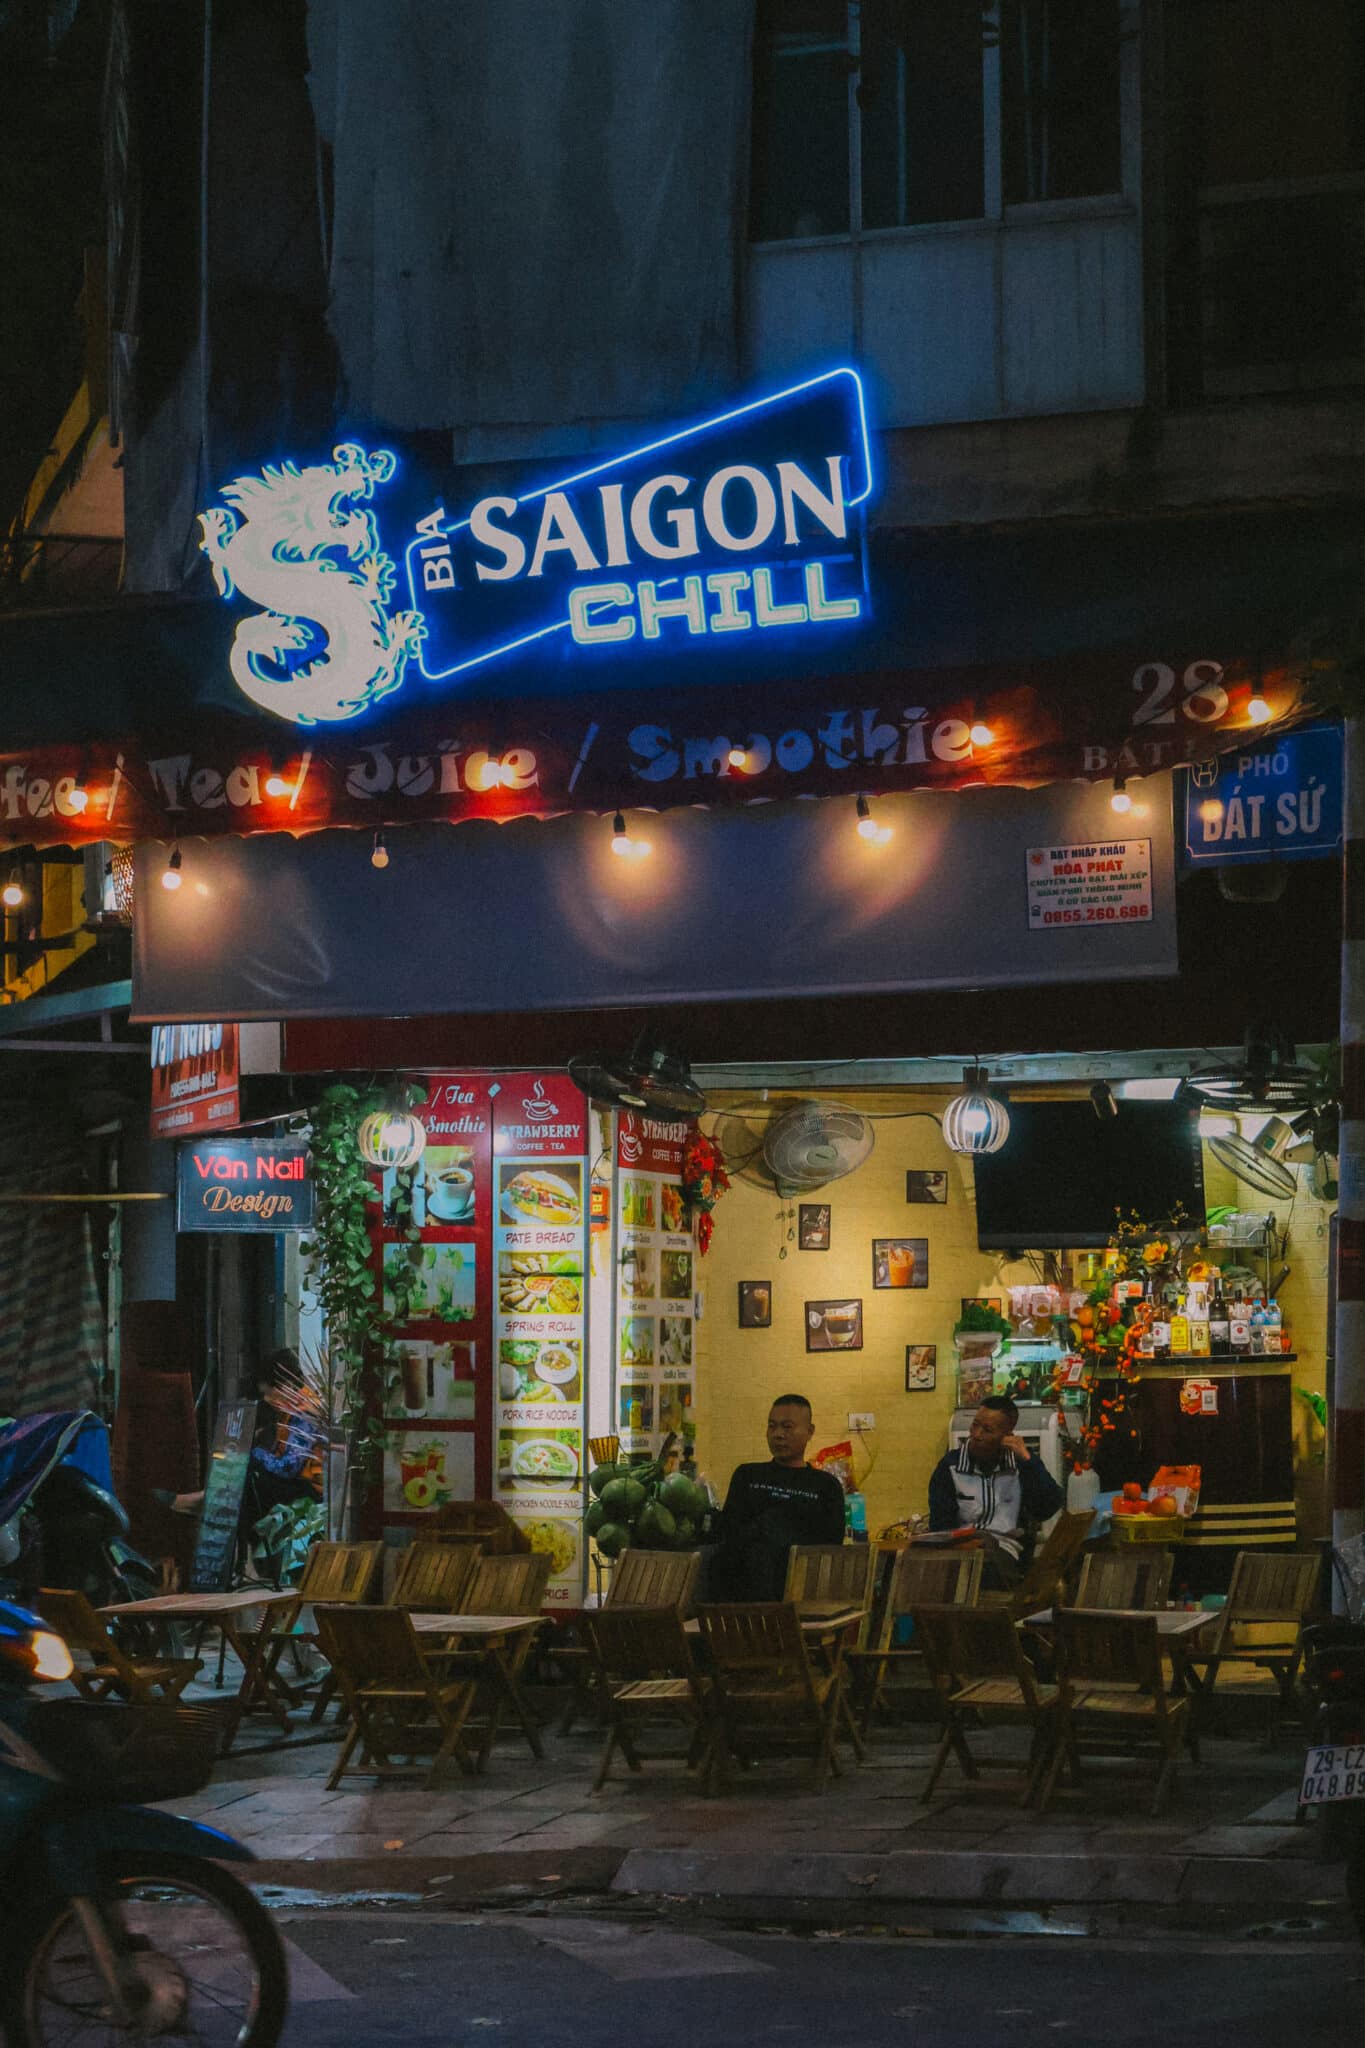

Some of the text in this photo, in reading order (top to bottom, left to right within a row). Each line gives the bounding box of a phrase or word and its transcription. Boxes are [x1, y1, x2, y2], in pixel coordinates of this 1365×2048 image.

[469, 455, 848, 581] SAIGON
[416, 507, 454, 592] BIA
[568, 561, 861, 645] CHILL
[1131, 659, 1230, 726] 28
[148, 754, 264, 812] Tea
[345, 738, 540, 798] Juice
[627, 705, 974, 784] Smoothie
[1275, 775, 1328, 837] SỨ
[445, 1084, 475, 1105] Tea
[500, 1123, 581, 1139] STRAWBERRY
[516, 1142, 545, 1151] COFFEE
[550, 1142, 566, 1150] TEA
[256, 1156, 305, 1180] Nail
[202, 1185, 294, 1219] Design
[505, 1231, 576, 1245] PATE BREAD
[548, 1320, 577, 1332] ROLL
[501, 1408, 523, 1421] PORK
[525, 1409, 545, 1421] RICE
